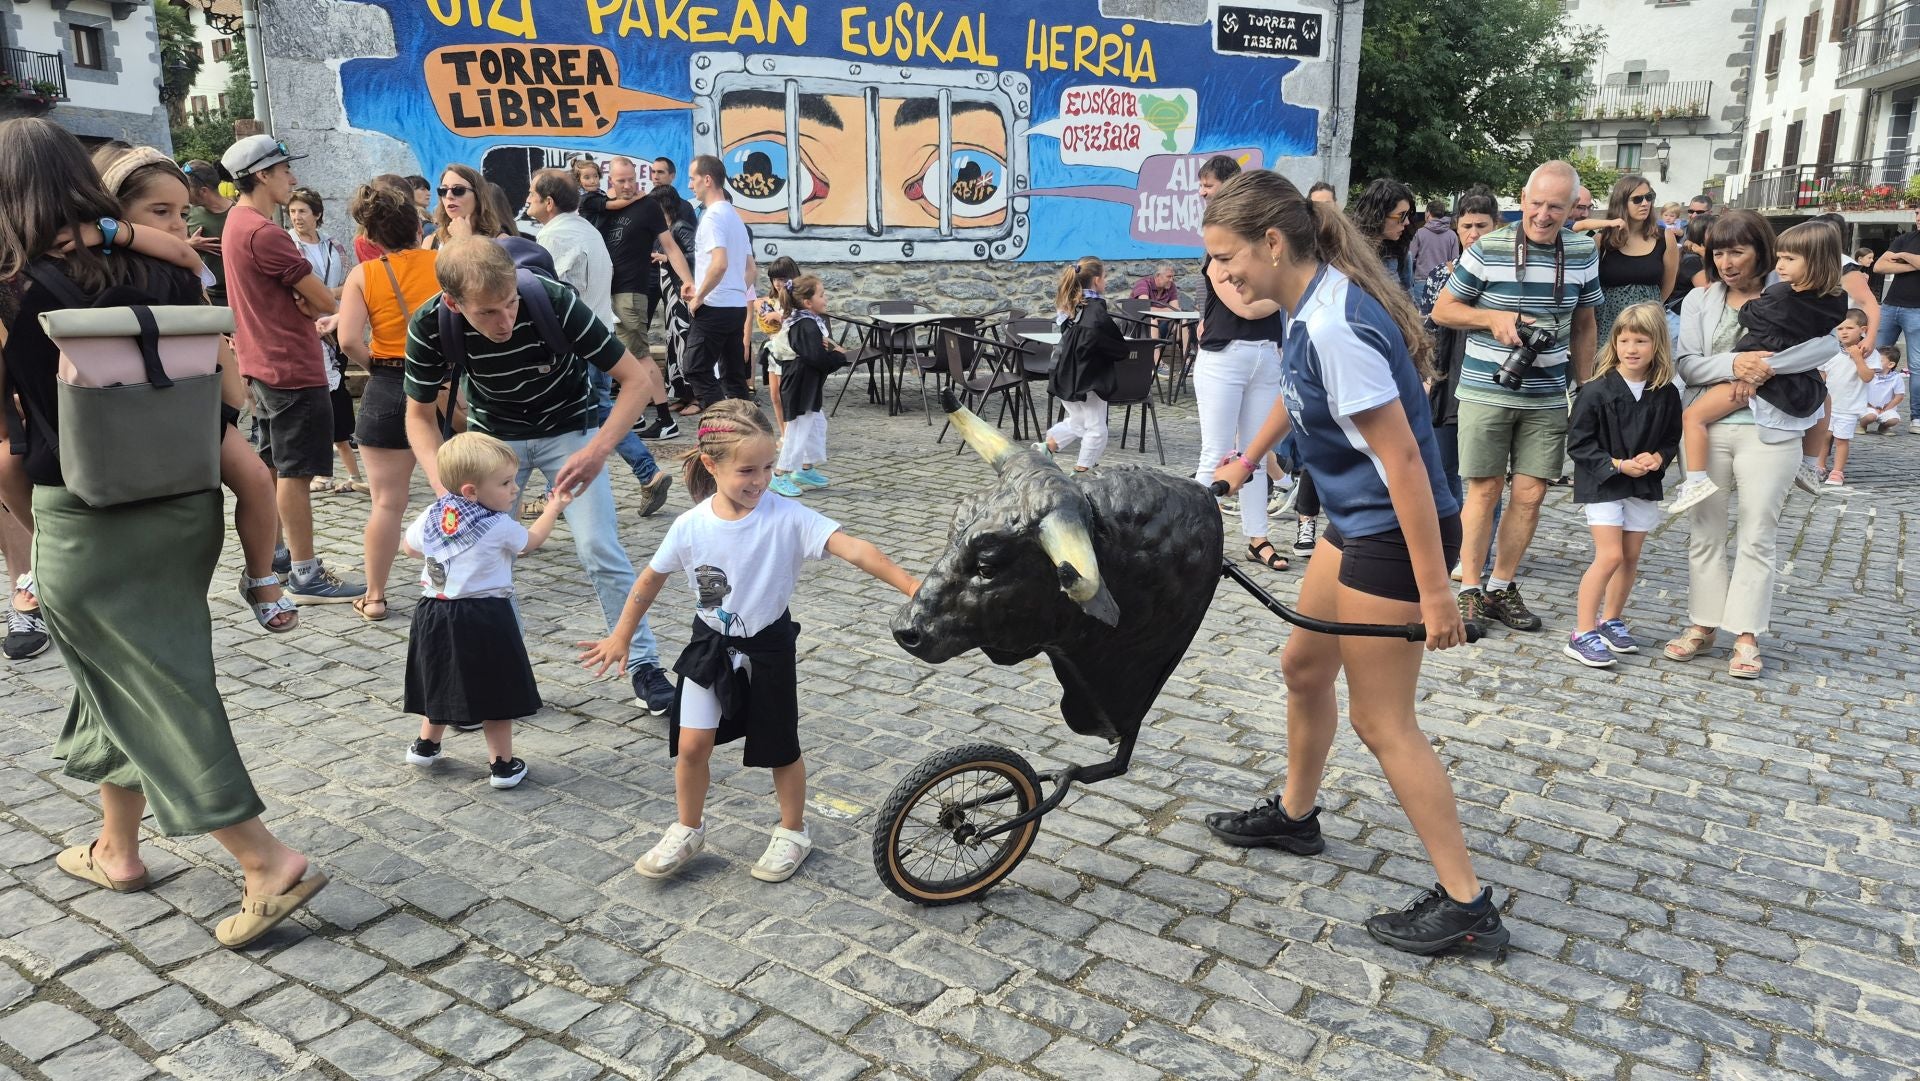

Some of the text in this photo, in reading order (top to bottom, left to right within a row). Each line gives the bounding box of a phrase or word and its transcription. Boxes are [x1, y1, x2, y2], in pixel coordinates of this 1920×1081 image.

[586, 0, 808, 46] PAKEAN
[841, 3, 999, 67] EUSKAL
[1249, 14, 1297, 34] TORREA
[1243, 34, 1298, 51] TABERNA
[440, 47, 614, 86] TORREA
[1166, 157, 1208, 192] AL
